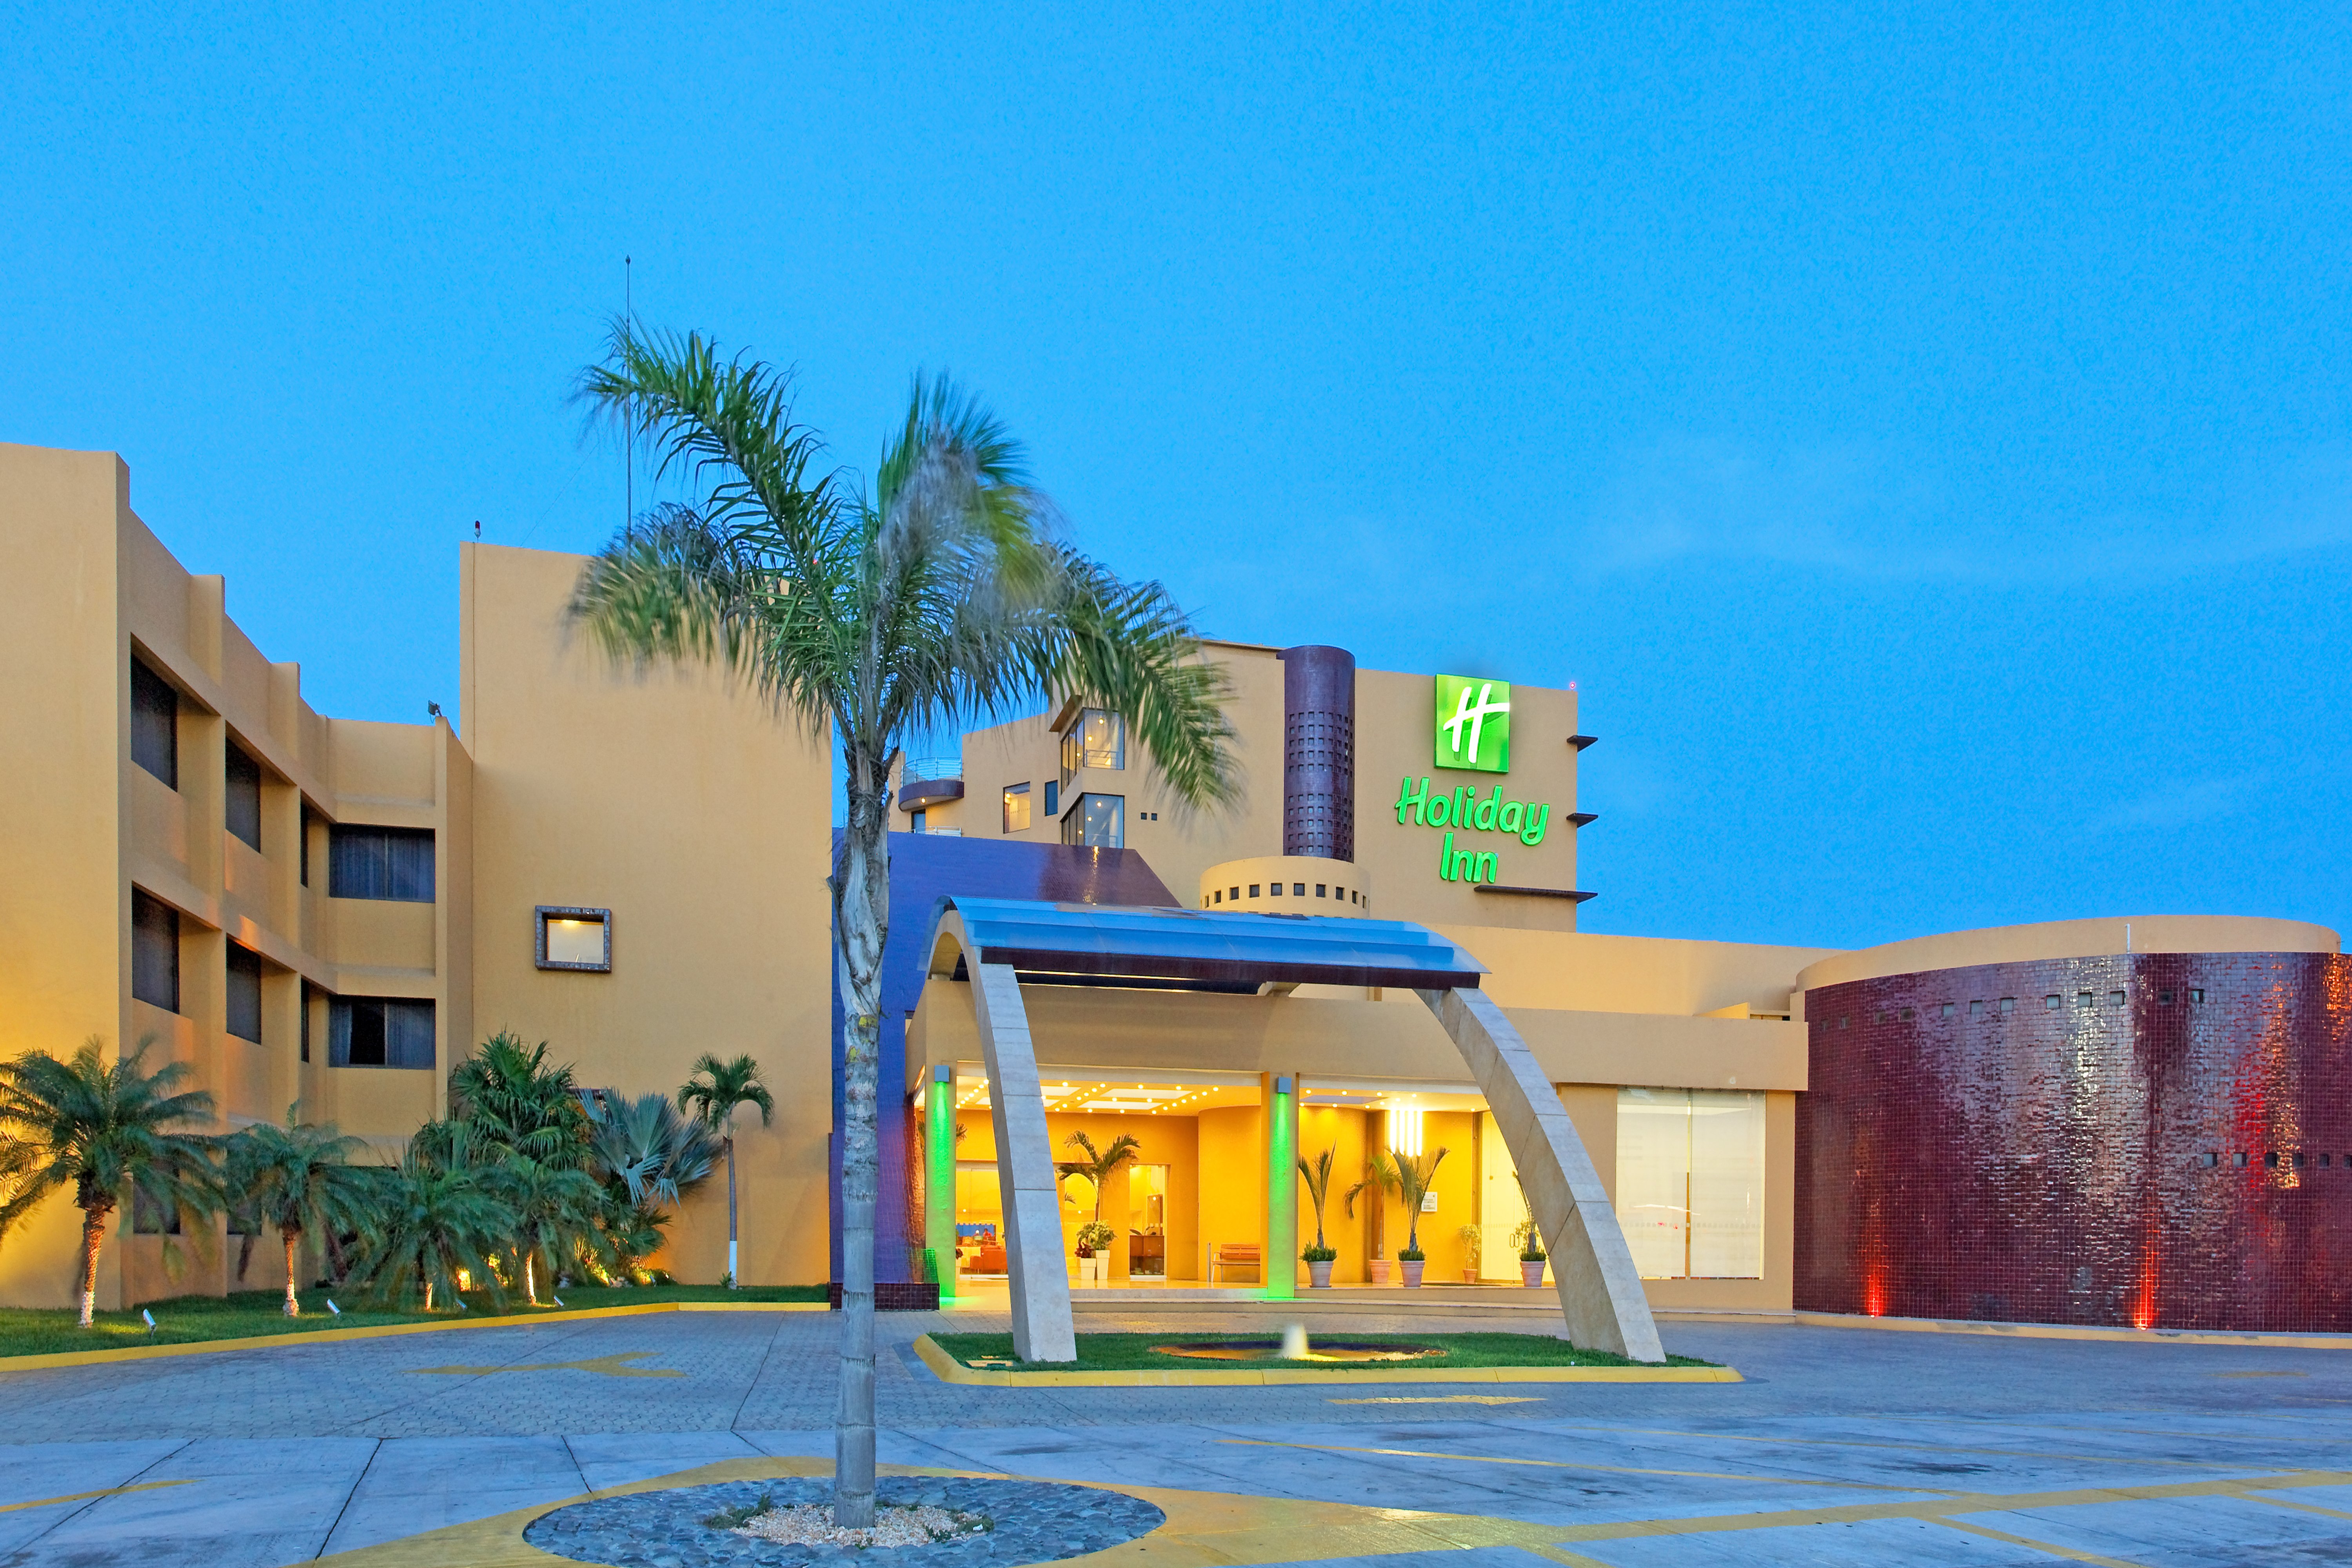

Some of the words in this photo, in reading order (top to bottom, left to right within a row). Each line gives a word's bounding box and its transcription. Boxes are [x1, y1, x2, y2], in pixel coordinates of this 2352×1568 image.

[1443, 683, 1509, 763] H
[1395, 777, 1549, 846] Holiday
[1440, 831, 1498, 883] Inn
